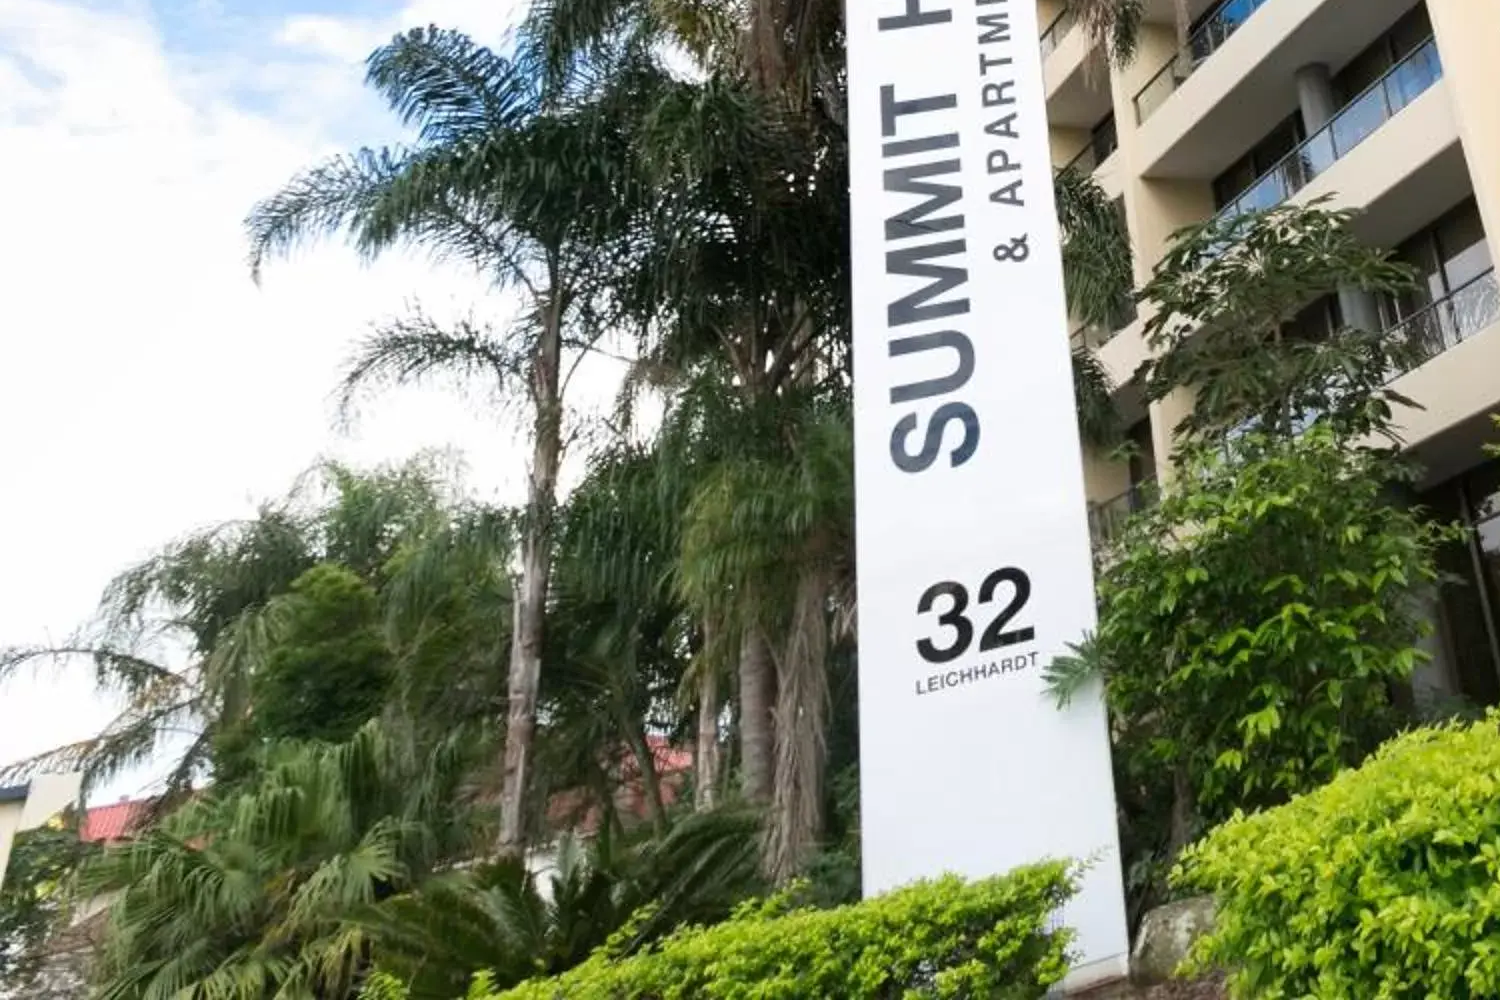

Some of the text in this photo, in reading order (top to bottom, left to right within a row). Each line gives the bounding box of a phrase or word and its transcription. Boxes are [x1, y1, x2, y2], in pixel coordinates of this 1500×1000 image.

[880, 84, 980, 473] SUMMIT
[993, 232, 1029, 263] &
[915, 566, 1035, 664] 32
[915, 651, 1040, 695] LEICHHARDT
